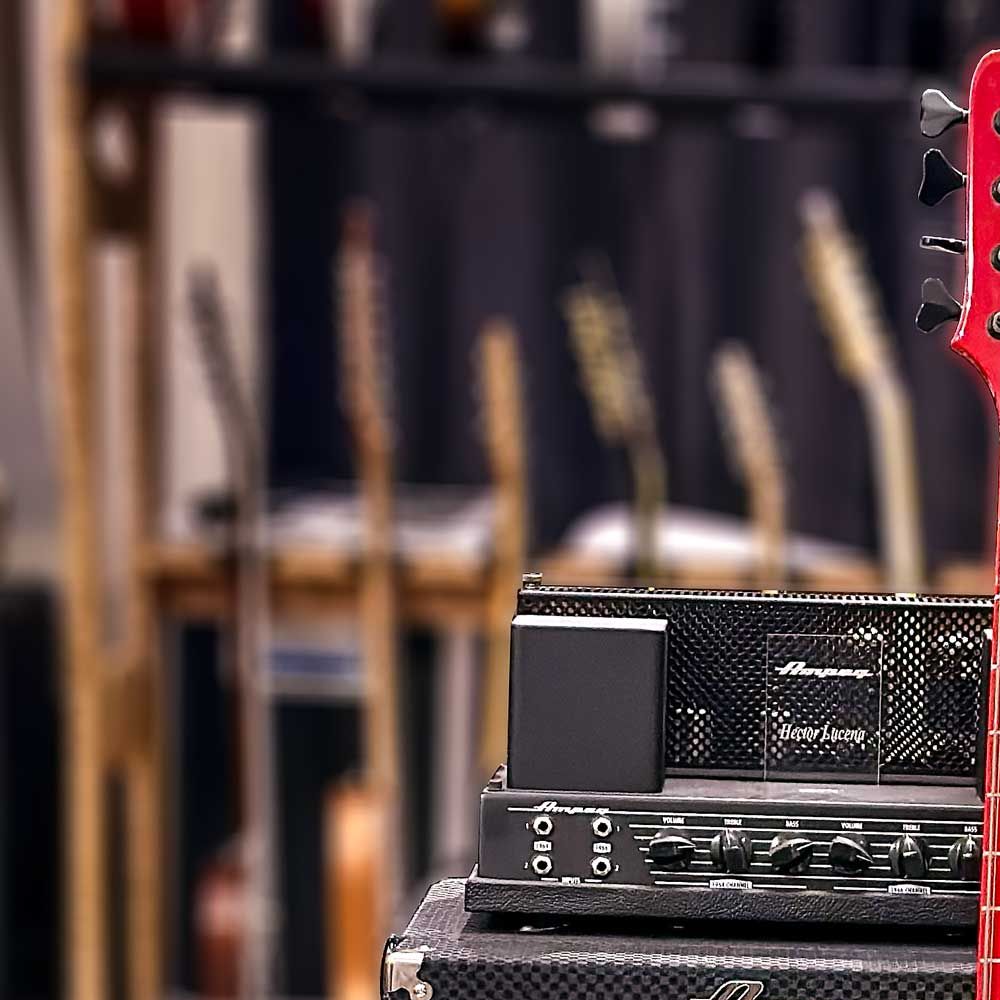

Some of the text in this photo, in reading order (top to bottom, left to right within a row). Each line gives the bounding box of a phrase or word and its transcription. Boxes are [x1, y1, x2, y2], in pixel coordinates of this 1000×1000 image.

[775, 661, 873, 679] Ampeg
[780, 723, 866, 743] Hector Lucena
[533, 801, 610, 815] Ampeg
[662, 816, 685, 824] VOLUME
[724, 818, 742, 826] TREBLE
[785, 820, 800, 828] BASS
[841, 822, 863, 830] VOLUME
[964, 825, 978, 833] BASS
